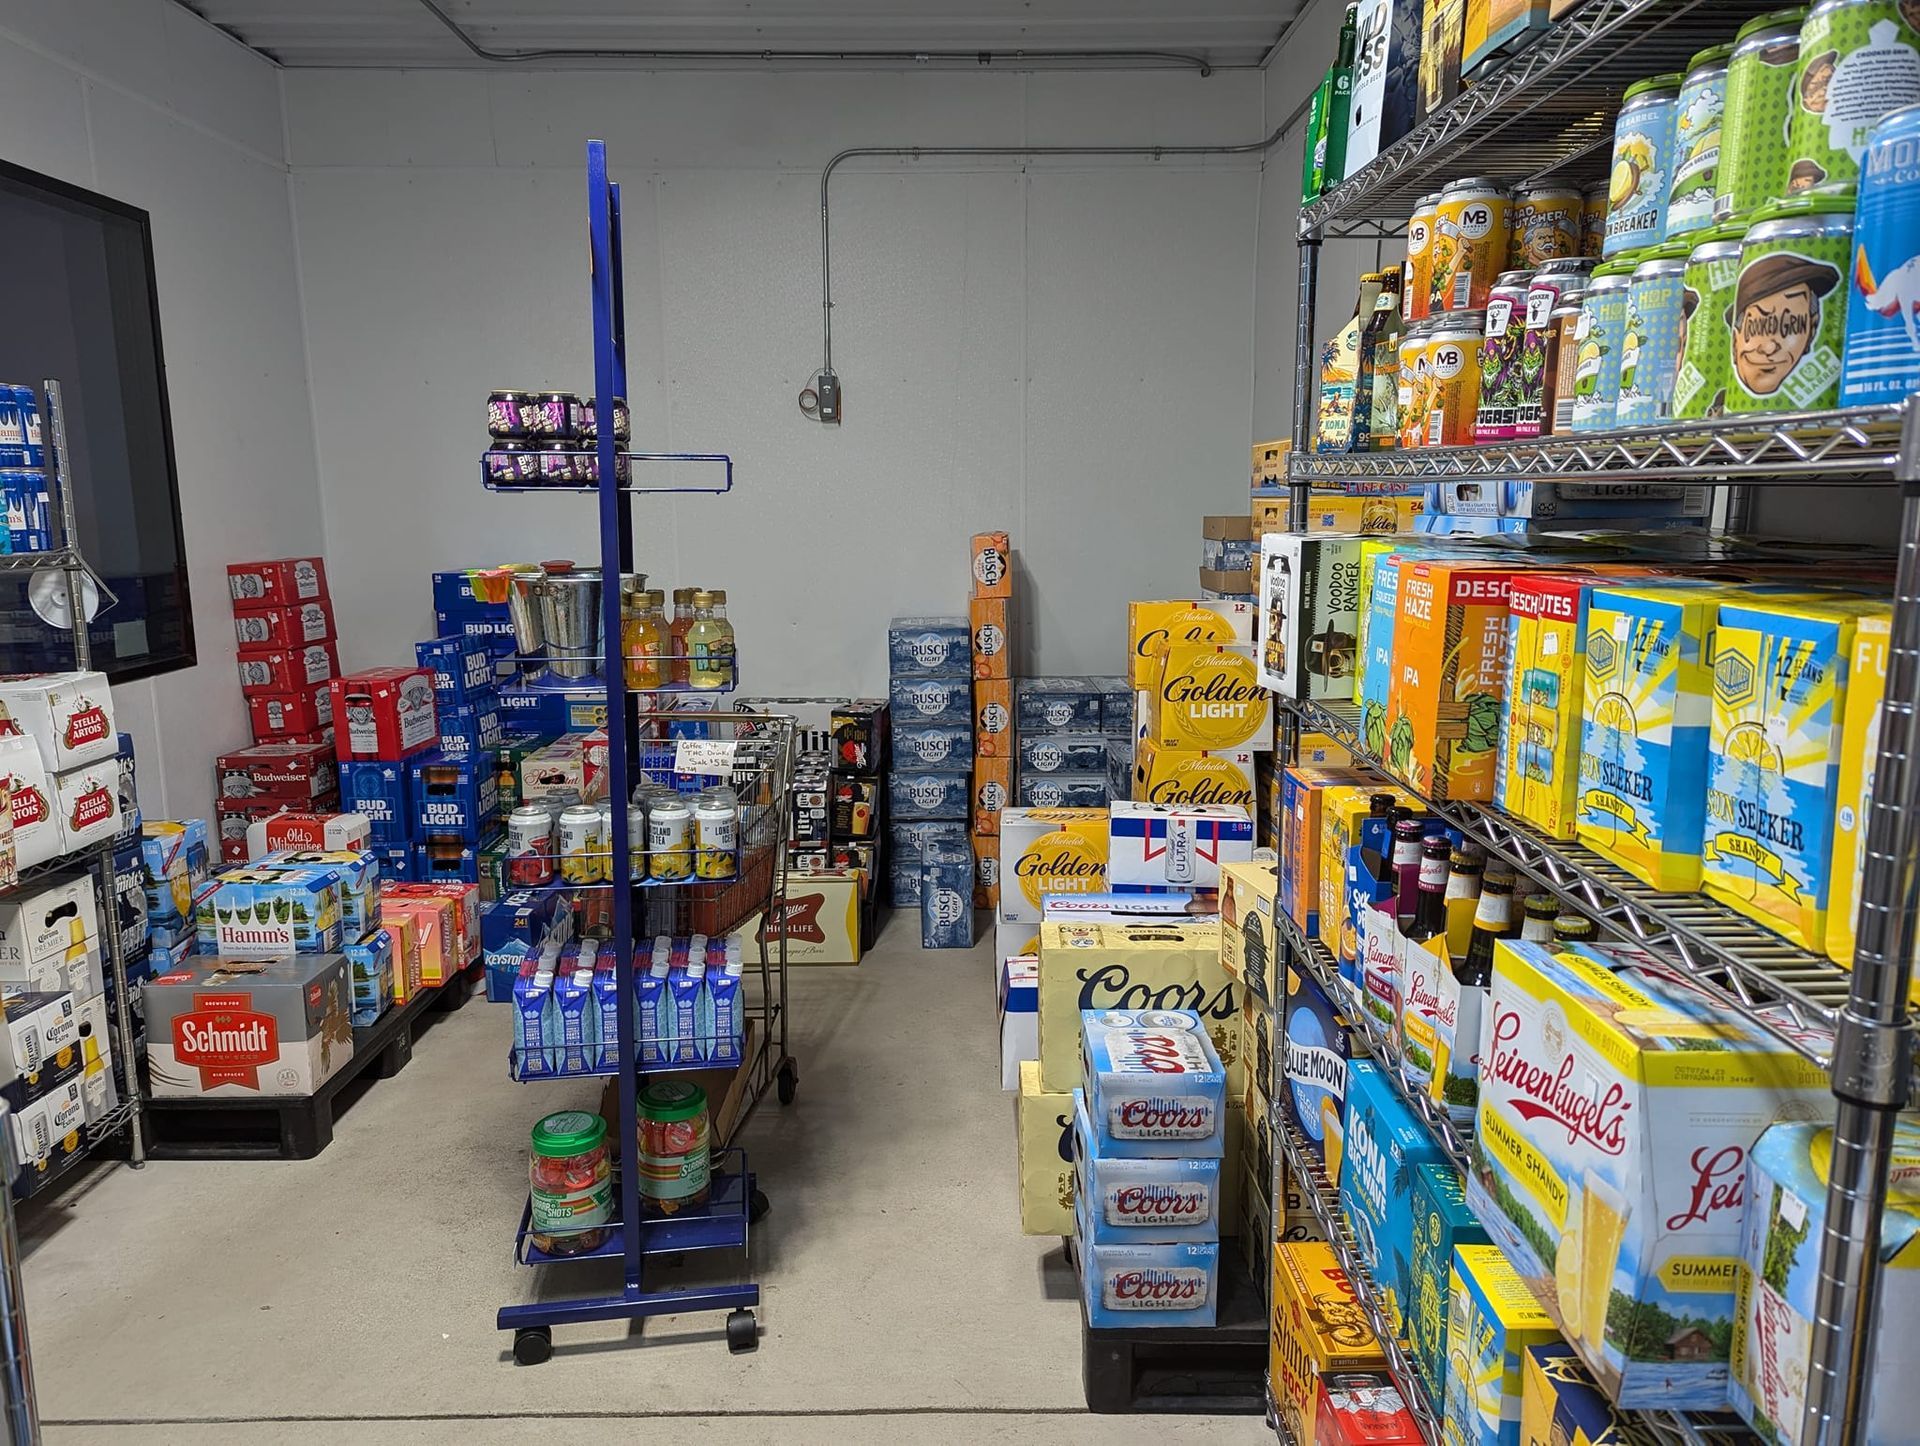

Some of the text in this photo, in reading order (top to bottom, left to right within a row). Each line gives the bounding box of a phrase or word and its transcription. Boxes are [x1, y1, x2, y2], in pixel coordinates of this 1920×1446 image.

[1337, 75, 1350, 90] 6
[1463, 211, 1487, 224] MB
[1613, 209, 1657, 235] BREAKER
[1410, 228, 1425, 241] MB
[1744, 306, 1778, 343] CROOKED
[1780, 308, 1808, 339] GRIN
[1436, 351, 1458, 366] MB
[1783, 350, 1832, 396] HOP
[1324, 418, 1346, 431] KONA
[1594, 484, 1650, 496] LIGHT
[1410, 502, 1424, 510] 24
[1362, 516, 1398, 532] Golden
[1513, 522, 1524, 533] 24
[1665, 521, 1676, 529] 24
[984, 548, 997, 587] BUSCH
[1344, 562, 1359, 612] RANGER
[1377, 569, 1397, 588] FRES
[1327, 562, 1344, 615] VOODOO
[1406, 579, 1434, 599] FRESH
[1404, 598, 1432, 620] HAZE
[1510, 590, 1572, 616] DESCHUTES
[1173, 612, 1215, 623] Michelob
[465, 624, 515, 634] BUD LIG
[984, 624, 993, 656] BUSCH
[1632, 632, 1670, 658] 12 CANS
[466, 652, 486, 666] BUD
[911, 644, 949, 656] BUSCH
[1376, 647, 1389, 665] IPA
[1480, 617, 1499, 686] FRESH
[1193, 655, 1244, 667] Michelob
[1775, 654, 1823, 684] 12 CANS
[464, 667, 491, 689] LIGHT
[1403, 666, 1419, 688] IPA
[1164, 674, 1270, 703] Golden
[500, 698, 537, 707] LIGHT
[912, 694, 950, 704] BUSCH
[404, 711, 432, 729] Budweiser
[989, 702, 998, 734] BUSCH
[1045, 709, 1074, 718] BUSCH
[1190, 703, 1248, 719] LIGHT
[73, 714, 101, 730] STELLA
[480, 713, 497, 729] BUD
[73, 724, 102, 740] ARTOIS
[442, 735, 464, 743] BUD
[479, 726, 503, 748] LIGHT
[440, 742, 470, 752] LIGHT
[914, 741, 951, 752] BUSCH
[1029, 752, 1064, 762] BUSCH
[1178, 759, 1228, 771] Michelob
[253, 772, 307, 783] Budweiser
[1581, 751, 1653, 802] SUN SEEKER
[480, 779, 496, 797] BUD
[909, 788, 946, 799] BUSCH
[988, 781, 997, 812] BUSCH
[1029, 791, 1064, 800] BUSCH
[1150, 778, 1256, 805] Golden
[79, 803, 107, 821] ARTOIS
[80, 795, 107, 812] STELLA
[356, 799, 387, 811] BUD
[427, 803, 458, 814] BUD
[478, 792, 500, 817] LIGHT
[1594, 793, 1625, 816] SHANDY
[421, 814, 465, 825] LIGHT
[1707, 787, 1804, 851] SUN SEEKER
[287, 828, 312, 842] Old
[1372, 824, 1379, 834] 6
[1039, 833, 1085, 847] Michelob
[1176, 831, 1186, 873] ULTRA
[1729, 837, 1769, 865] SHANDY
[983, 857, 992, 887] BUSCH
[1014, 852, 1106, 877] Golden
[1038, 877, 1090, 891] LIGHT
[940, 888, 950, 927] BUSCH
[1049, 901, 1111, 910] Coors
[38, 928, 59, 944] Corona
[222, 927, 290, 944] Hamm's
[793, 924, 814, 933] LIFE
[33, 935, 65, 954] PREMIER
[1571, 956, 1652, 1007] SUMMER SHANDY
[1076, 965, 1240, 1020] Coors
[46, 1018, 74, 1042] Corona
[182, 1019, 268, 1054] Schmidt
[55, 1034, 69, 1045] Extra
[1584, 1019, 1630, 1067] 12 BOTTLES
[1283, 1039, 1345, 1094] BLUE MOON
[1193, 1074, 1204, 1083] 12
[1481, 1001, 1632, 1155] Leinenkugel's
[1297, 1085, 1321, 1115] BELGIAN
[54, 1103, 80, 1127] Corona
[1120, 1100, 1205, 1128] Coors
[1298, 1101, 1322, 1129] WHITE
[62, 1119, 76, 1130] Extra
[1139, 1129, 1181, 1137] LIGHT
[1349, 1104, 1387, 1198] KONA
[1390, 1139, 1399, 1158] 12
[1188, 1162, 1199, 1170] 12
[1483, 1108, 1566, 1209] SUMMER SHANDY
[1348, 1136, 1387, 1222] BIG WAVE
[1116, 1188, 1200, 1215] Coors
[547, 1208, 572, 1217] SHOTS
[1134, 1216, 1177, 1224] LIGHT
[1186, 1247, 1197, 1255] 12
[1115, 1272, 1197, 1299] Coors
[1132, 1300, 1173, 1308] LIGHT
[1273, 1304, 1318, 1394] Shiner
[1282, 1361, 1309, 1415] BOCK
